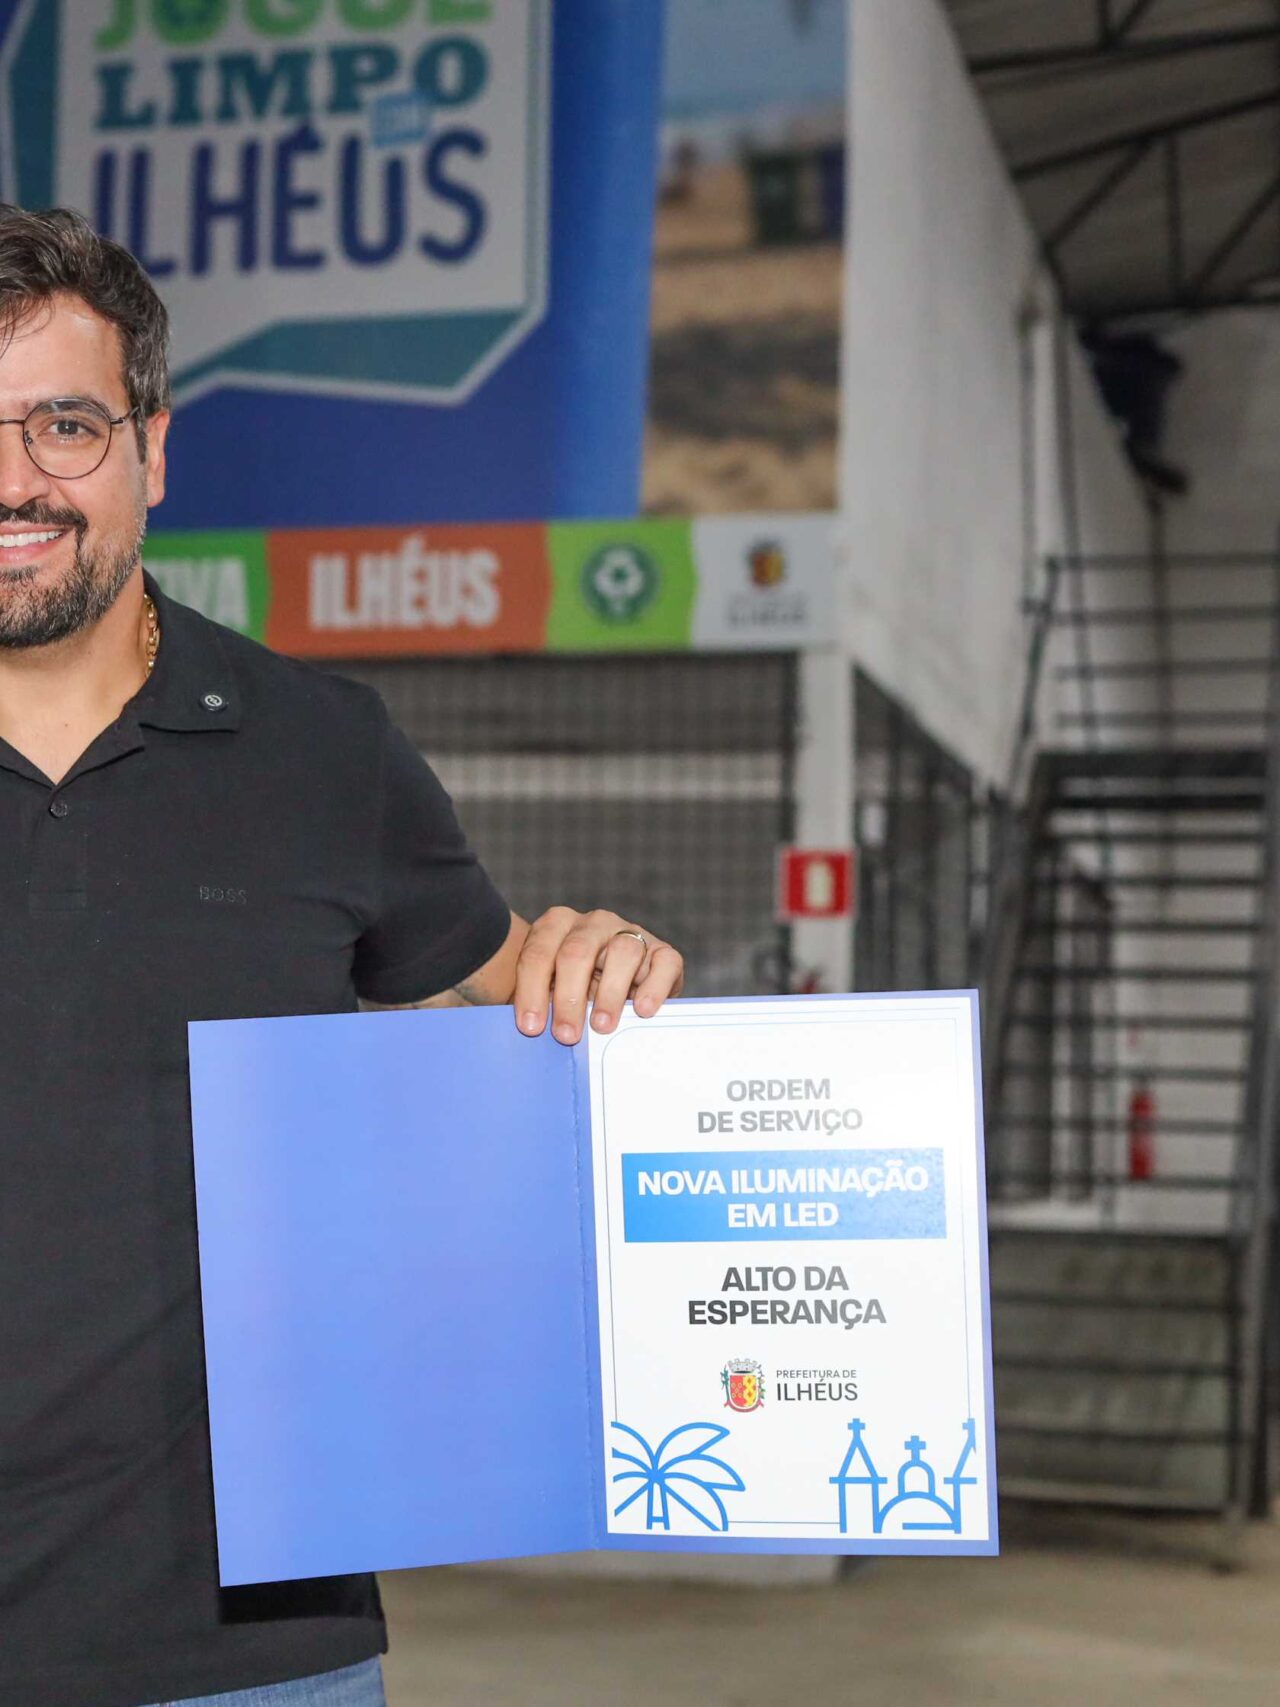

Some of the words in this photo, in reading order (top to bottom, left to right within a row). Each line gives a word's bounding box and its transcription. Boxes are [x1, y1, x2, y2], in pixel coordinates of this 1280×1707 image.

[94, 36, 489, 130] LIMPO
[93, 120, 488, 278] ILHÉUS
[308, 534, 501, 631] ILHÉUS
[198, 885, 248, 906] BOSS
[726, 1078, 831, 1102] ORDEM
[697, 1111, 734, 1133] DE
[739, 1108, 863, 1136] SERVIÇO
[637, 1170, 726, 1196] NOVA
[731, 1159, 929, 1198] ILUMINAÇÃO
[727, 1204, 776, 1228] EM
[783, 1202, 839, 1227] LED
[721, 1266, 797, 1292] ALTO
[803, 1265, 850, 1292] DA
[688, 1298, 888, 1330] ESPERANÇA
[776, 1369, 841, 1379] PREFEITURA
[842, 1369, 857, 1379] DE
[777, 1379, 858, 1401] ILHÉUS
